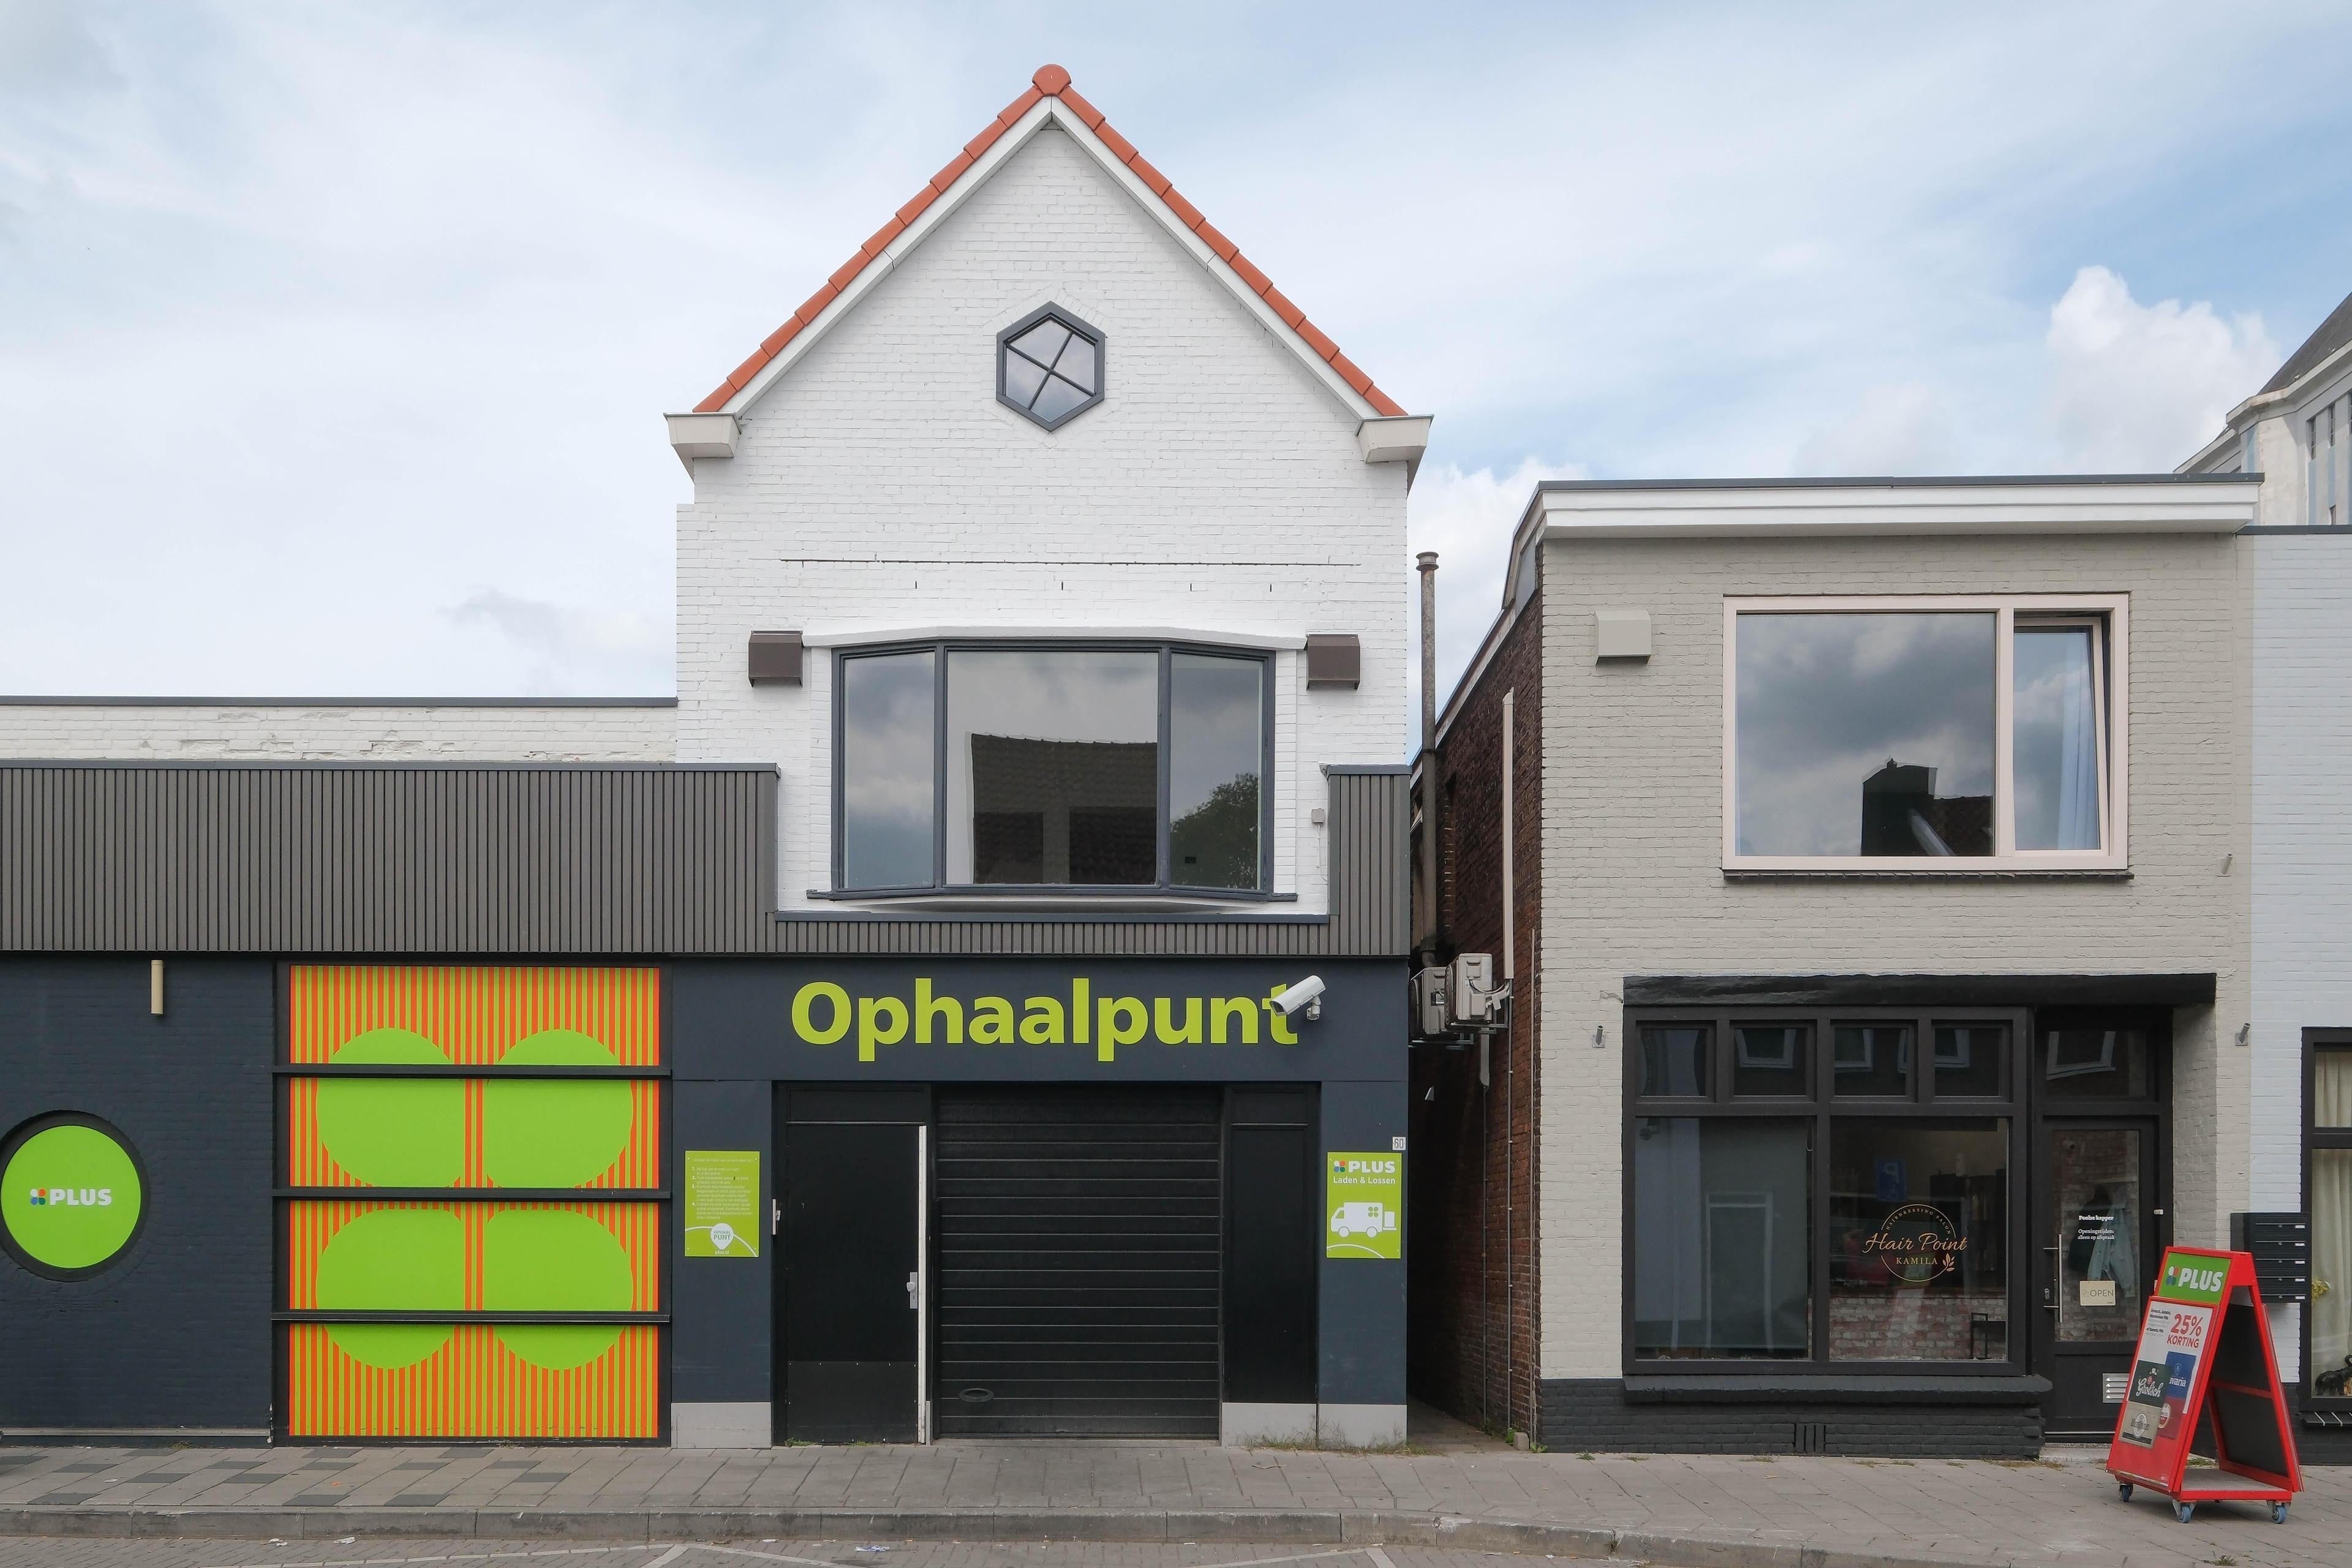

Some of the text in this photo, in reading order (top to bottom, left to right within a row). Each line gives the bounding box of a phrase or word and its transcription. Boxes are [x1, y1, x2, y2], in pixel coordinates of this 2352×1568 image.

[791, 978, 1298, 1062] Ophaalpunt
[1394, 1138, 1404, 1149] 60
[1348, 1161, 1396, 1173] PLUS
[49, 1188, 112, 1206] PLUS
[1886, 1208, 1951, 1235] HAIRDRESSING SALON
[1862, 1232, 1968, 1253] Hair Point
[2177, 1267, 2224, 1292] PLUS
[2170, 1313, 2204, 1336] 25%
[2166, 1334, 2199, 1349] KORTING
[2136, 1378, 2164, 1398] Grolsch
